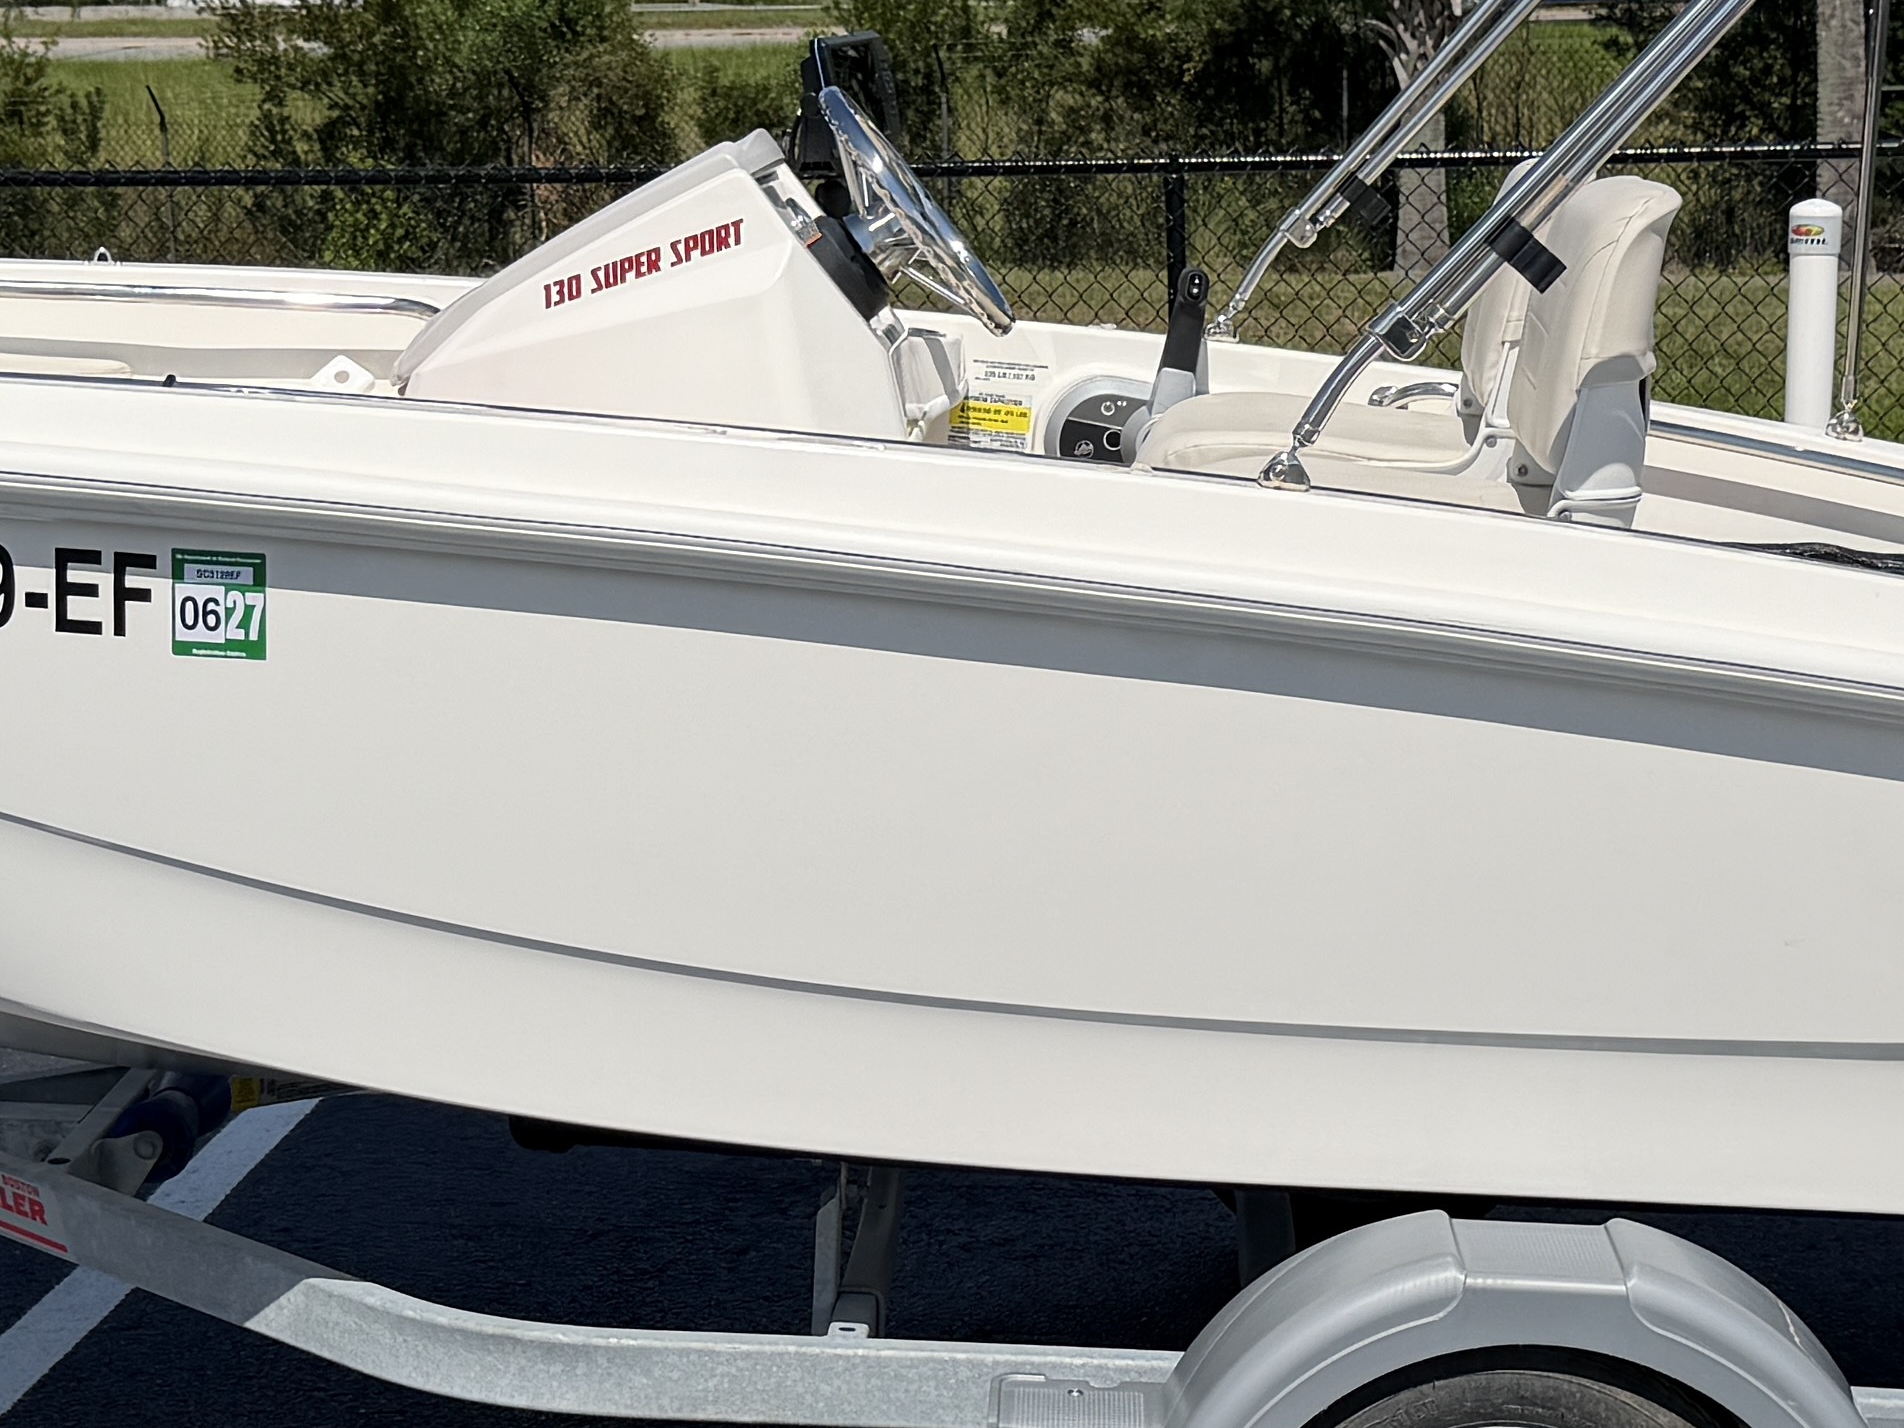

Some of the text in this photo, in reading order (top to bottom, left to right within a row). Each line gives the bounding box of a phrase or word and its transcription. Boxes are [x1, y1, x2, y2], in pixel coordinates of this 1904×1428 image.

[543, 218, 744, 310] 130 SUPER SPORT
[179, 590, 265, 641] 06 27
